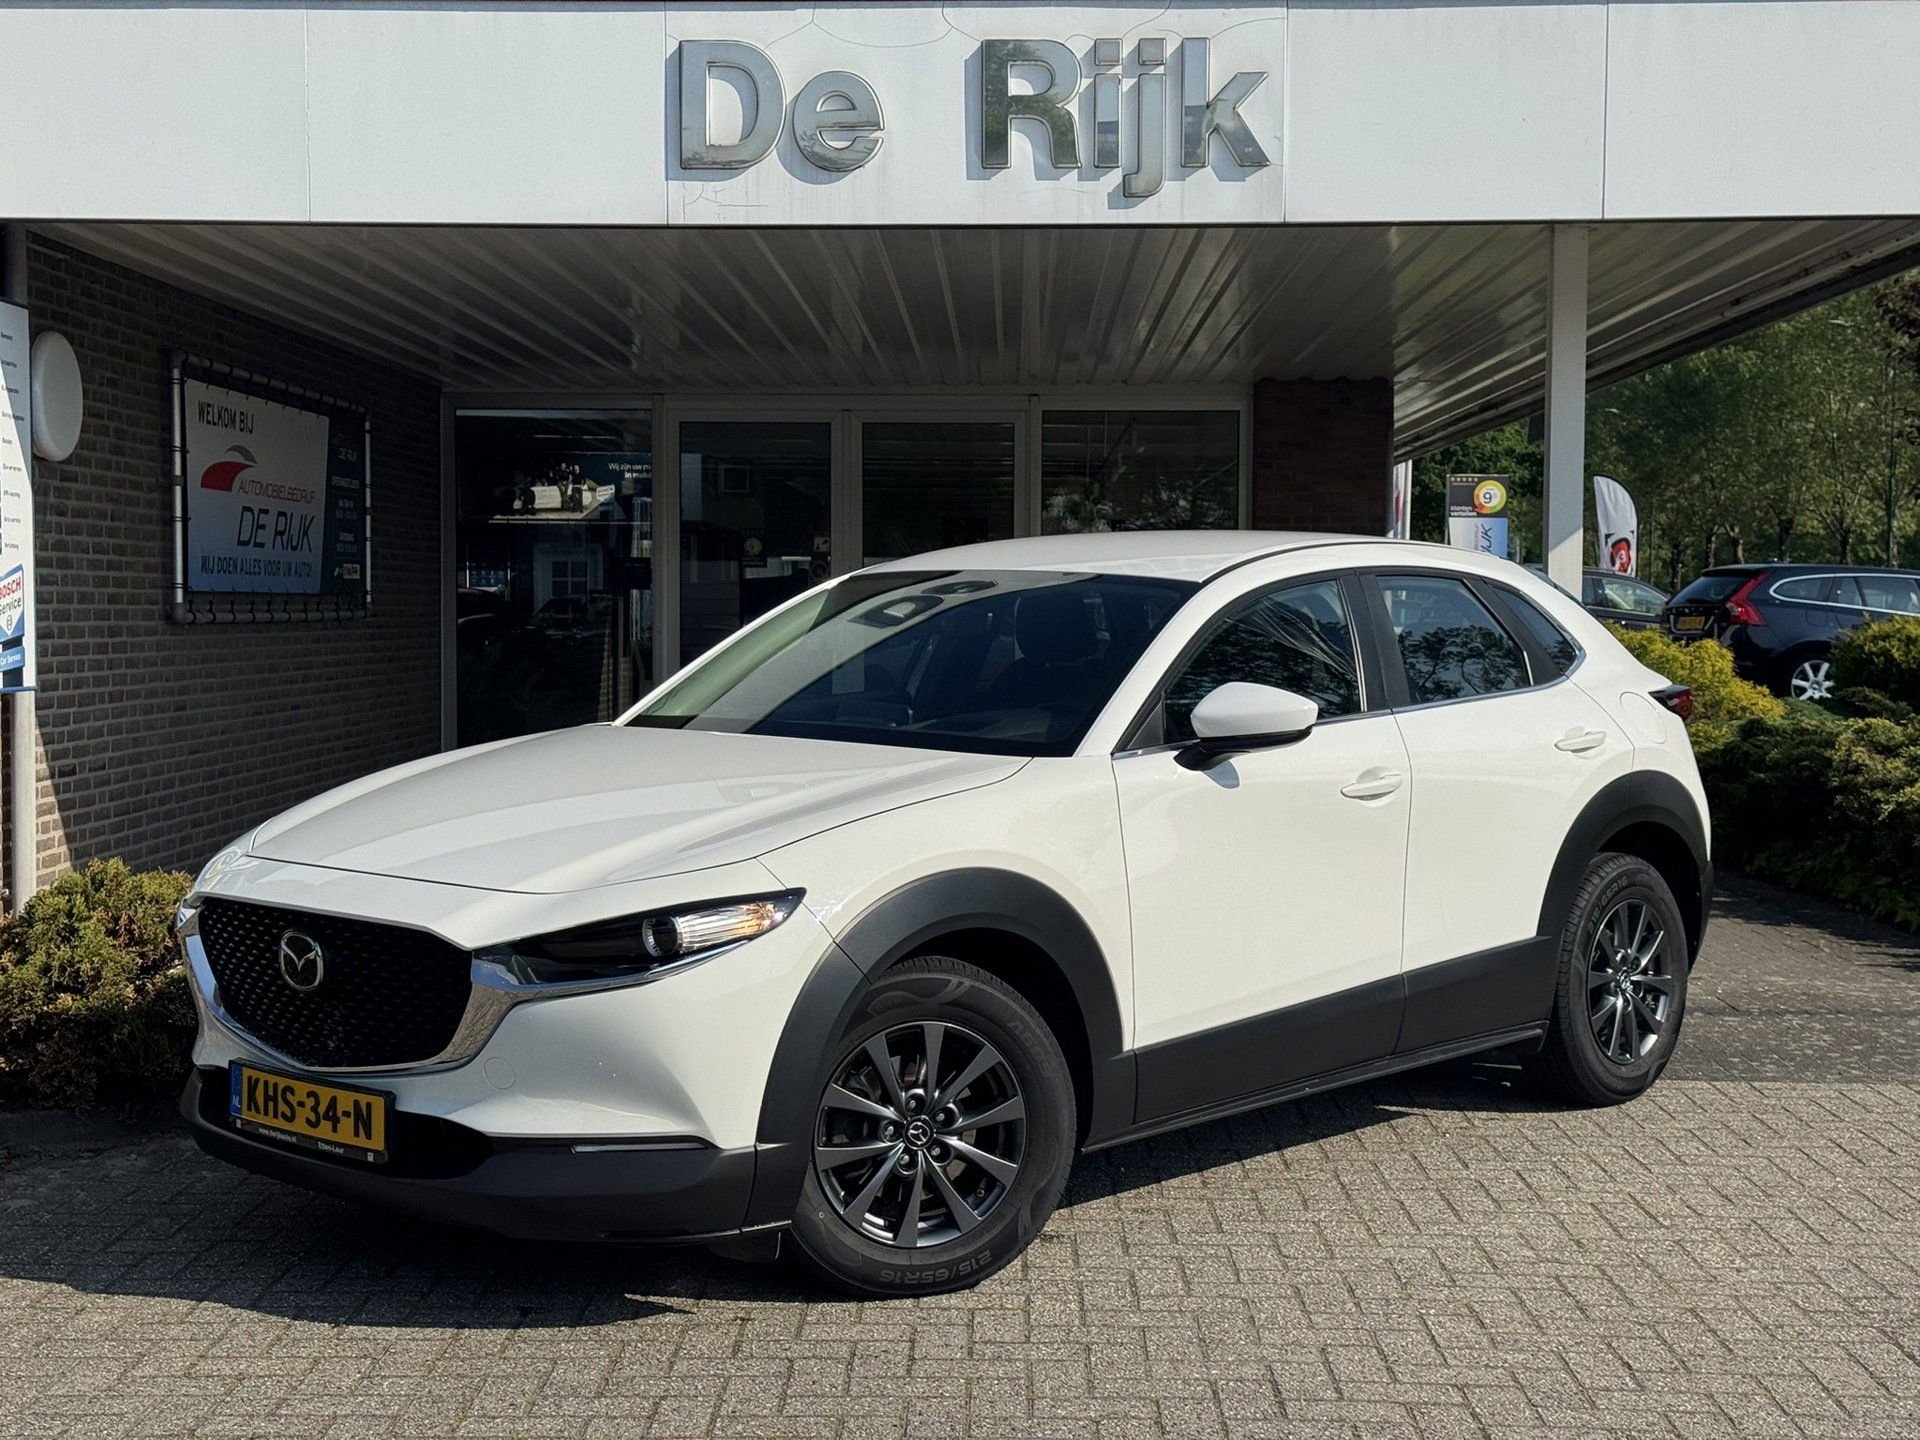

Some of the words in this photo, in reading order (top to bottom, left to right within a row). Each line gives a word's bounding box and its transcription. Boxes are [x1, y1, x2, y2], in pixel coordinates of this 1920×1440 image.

[680, 40, 885, 171] De
[981, 37, 1271, 198] Rijk
[198, 400, 237, 430] WELKOM
[240, 411, 255, 434] BIJ
[237, 506, 270, 548] DE
[272, 511, 316, 553] RIJK
[201, 555, 215, 574] WIJ
[217, 556, 238, 575] DOEN
[240, 558, 262, 576] ALLES
[263, 559, 281, 577] VOOR
[232, 1095, 241, 1108] NL
[246, 1074, 373, 1141] KHS-34-N
[879, 1249, 993, 1284] 215/65R16
